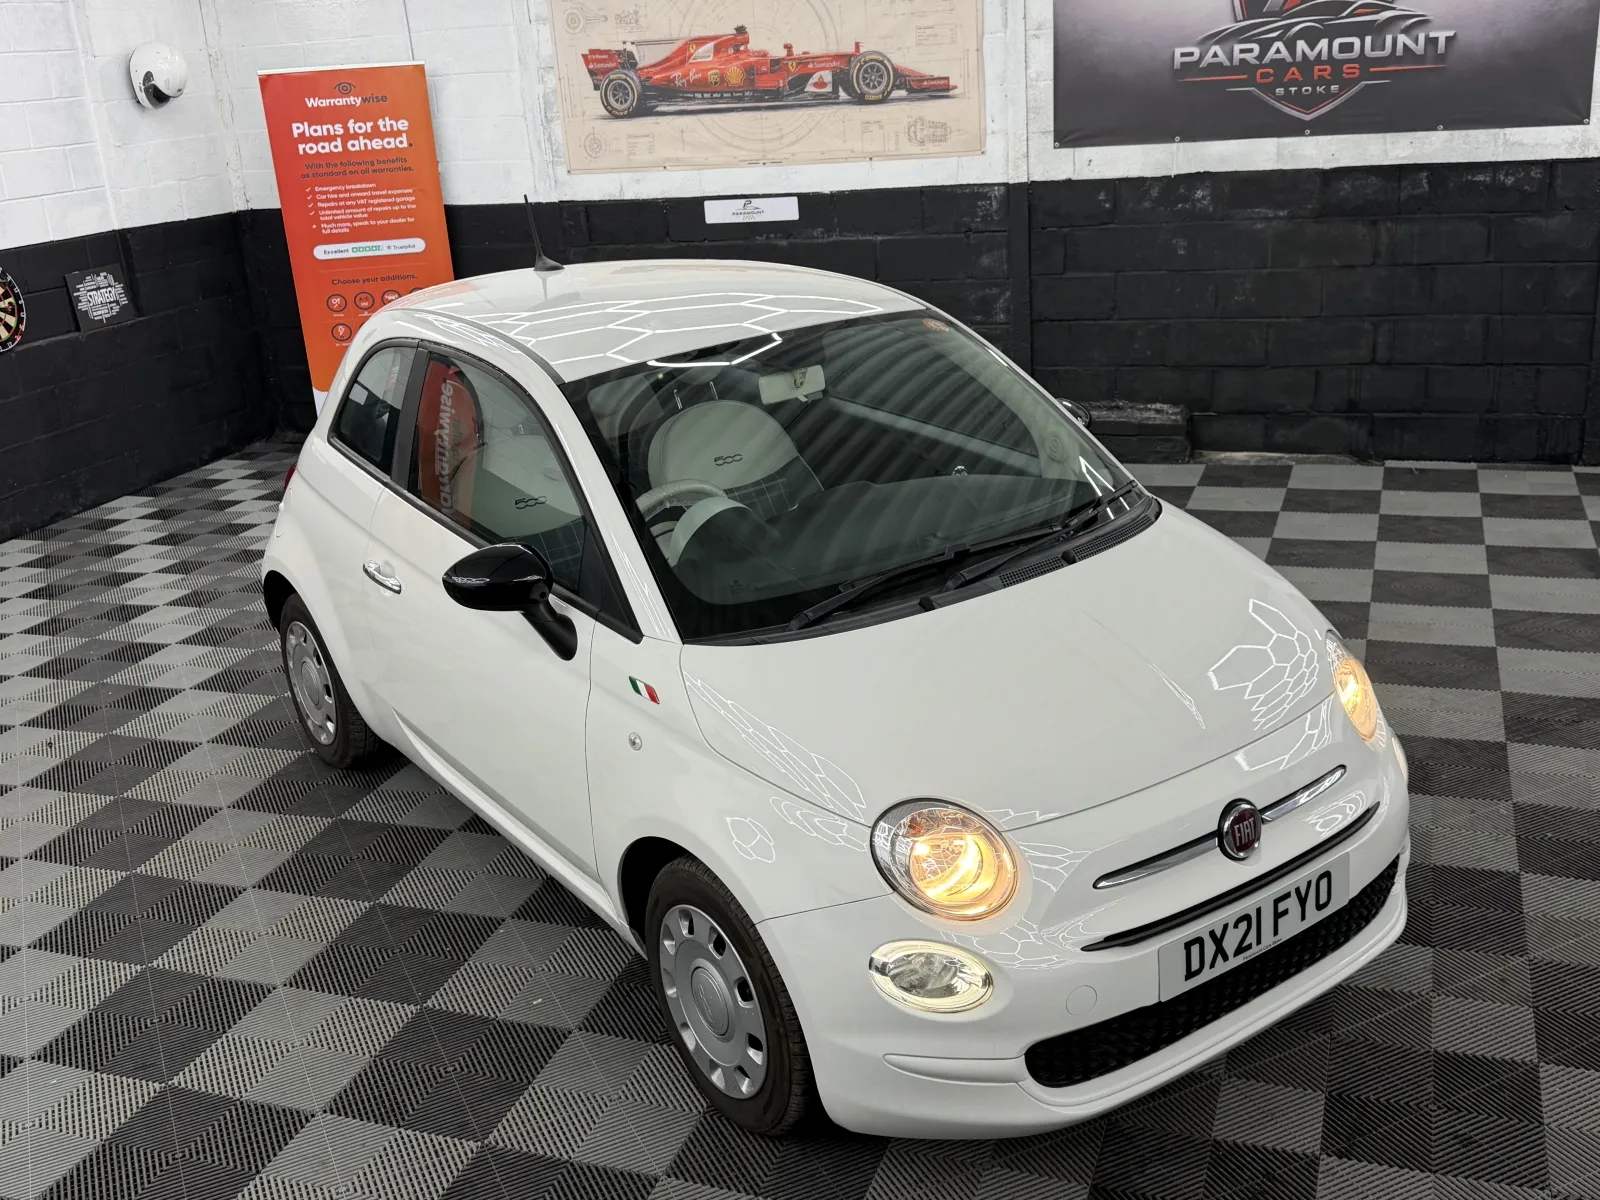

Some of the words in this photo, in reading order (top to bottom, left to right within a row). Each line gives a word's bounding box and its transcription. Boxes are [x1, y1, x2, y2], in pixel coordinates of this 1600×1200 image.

[1173, 30, 1457, 69] PARAMOUNT
[670, 68, 702, 87] Ray-Ban
[1256, 64, 1360, 83] CARS
[1275, 85, 1340, 96] STOKE
[305, 93, 388, 108] Warrantywise
[292, 120, 344, 138] Plans
[348, 119, 374, 134] for
[378, 116, 409, 131] the
[298, 138, 342, 155] road
[347, 133, 413, 151] ahead.
[312, 170, 347, 178] standard
[372, 165, 414, 174] warranties.
[326, 161, 338, 169] the
[340, 159, 375, 168] following
[377, 157, 408, 165] benefits
[380, 273, 418, 282] additions.
[86, 287, 117, 306] STRATEGY
[1234, 817, 1257, 846] FIAT
[1184, 906, 1262, 982] DX21
[1273, 870, 1332, 938] FYO
